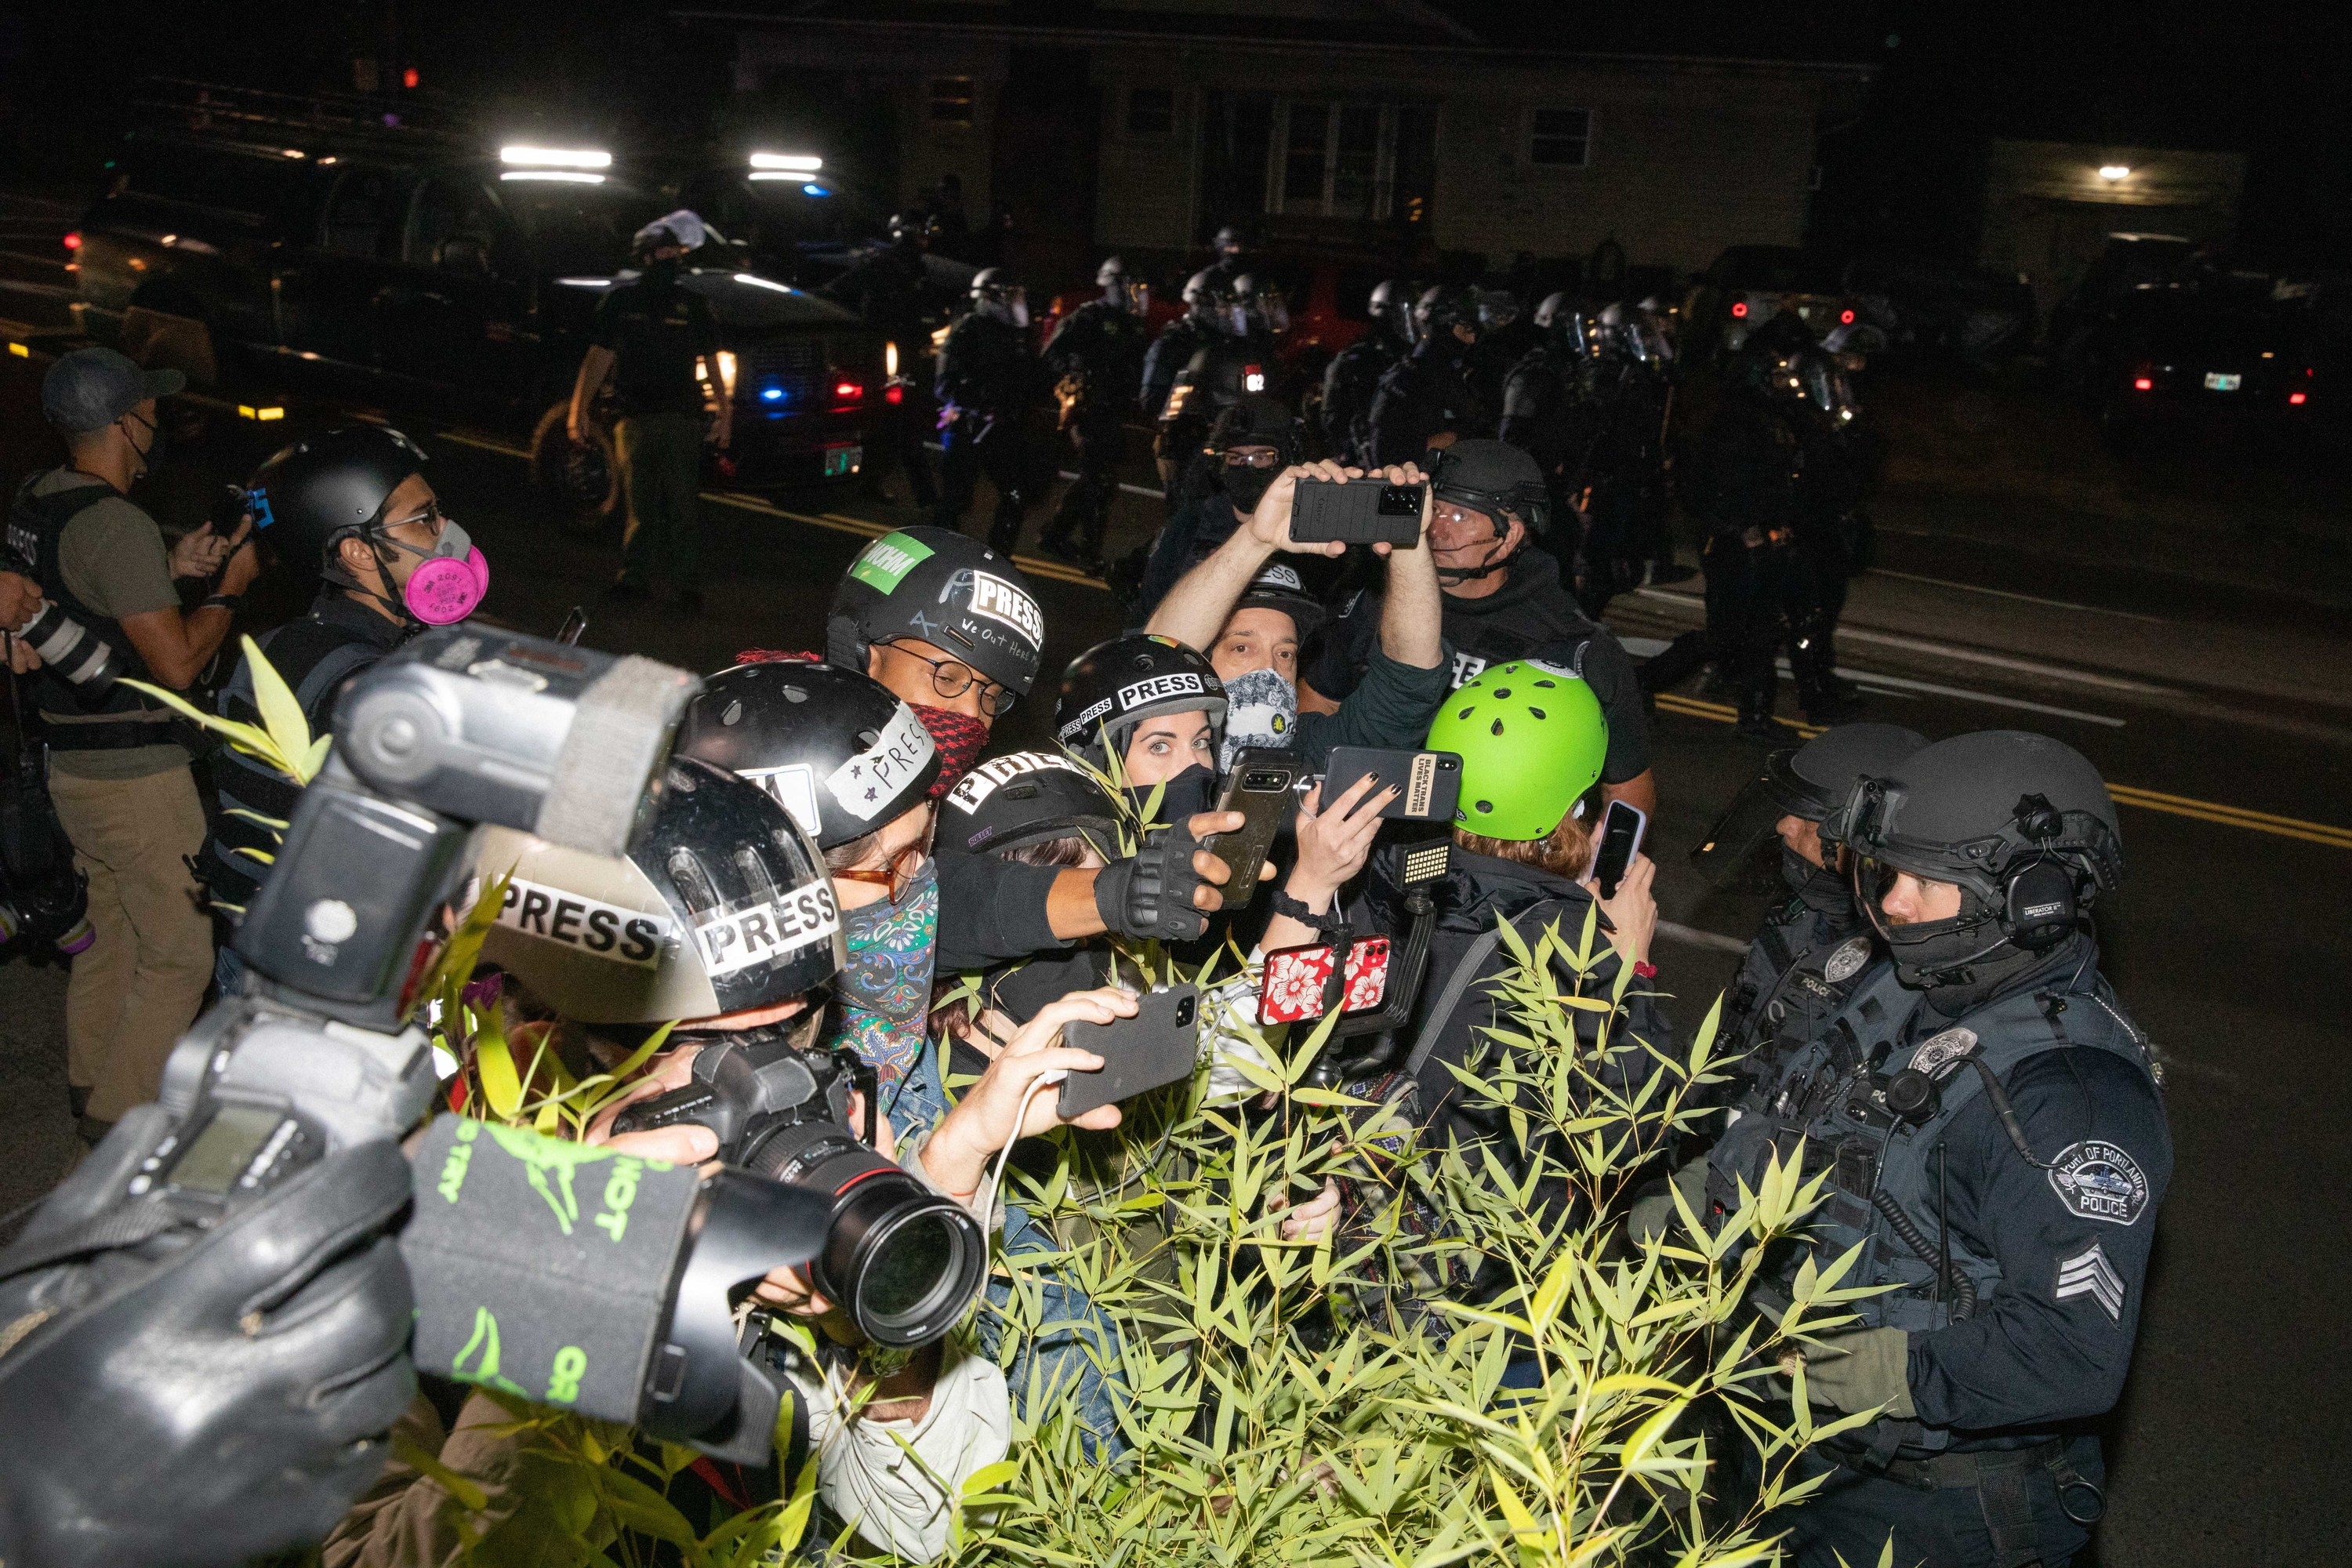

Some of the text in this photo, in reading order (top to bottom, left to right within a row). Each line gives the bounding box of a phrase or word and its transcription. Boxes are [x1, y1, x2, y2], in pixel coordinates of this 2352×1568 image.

[979, 579, 1042, 640] PRESS
[982, 629, 1007, 647] Out
[1121, 675, 1200, 706] PRESS
[1081, 700, 1110, 723] PRESS
[1062, 720, 1080, 737] PRESS
[873, 716, 929, 789] PRESS
[1411, 758, 1425, 813] LIVES MATTER
[1418, 759, 1432, 812] BLACK TRANS
[969, 827, 993, 845] BULLET
[495, 882, 659, 961] PRESS
[2025, 906, 2053, 916] LIBERATOR
[704, 887, 835, 965] PRESS
[2085, 1146, 2100, 1160] OF
[2080, 1196, 2128, 1218] POLICE
